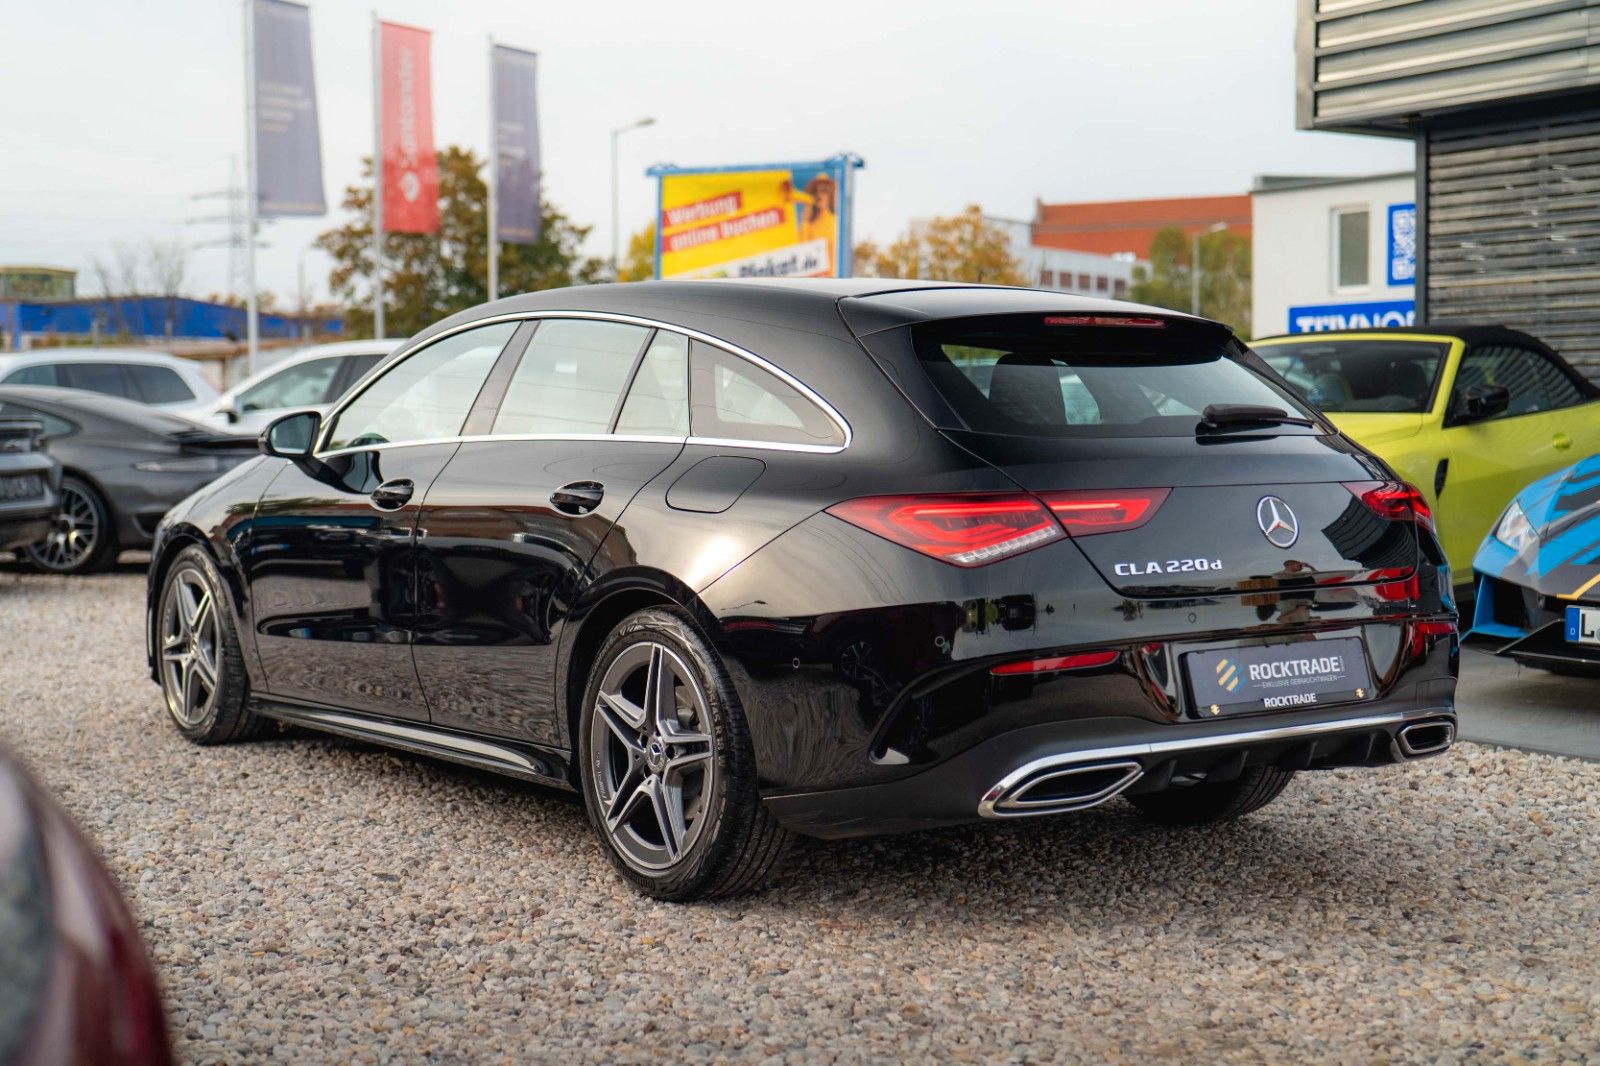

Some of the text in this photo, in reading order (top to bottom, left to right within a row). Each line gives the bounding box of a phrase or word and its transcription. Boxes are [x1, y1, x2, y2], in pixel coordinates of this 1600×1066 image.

[667, 195, 737, 224] Werbung
[671, 209, 780, 251] online buchen
[1114, 559, 1223, 576] CLA 220d
[1570, 627, 1576, 636] D
[1581, 613, 1595, 638] L
[1249, 656, 1341, 681] ROCKTRADE
[1263, 692, 1317, 709] ROCKTRADE
